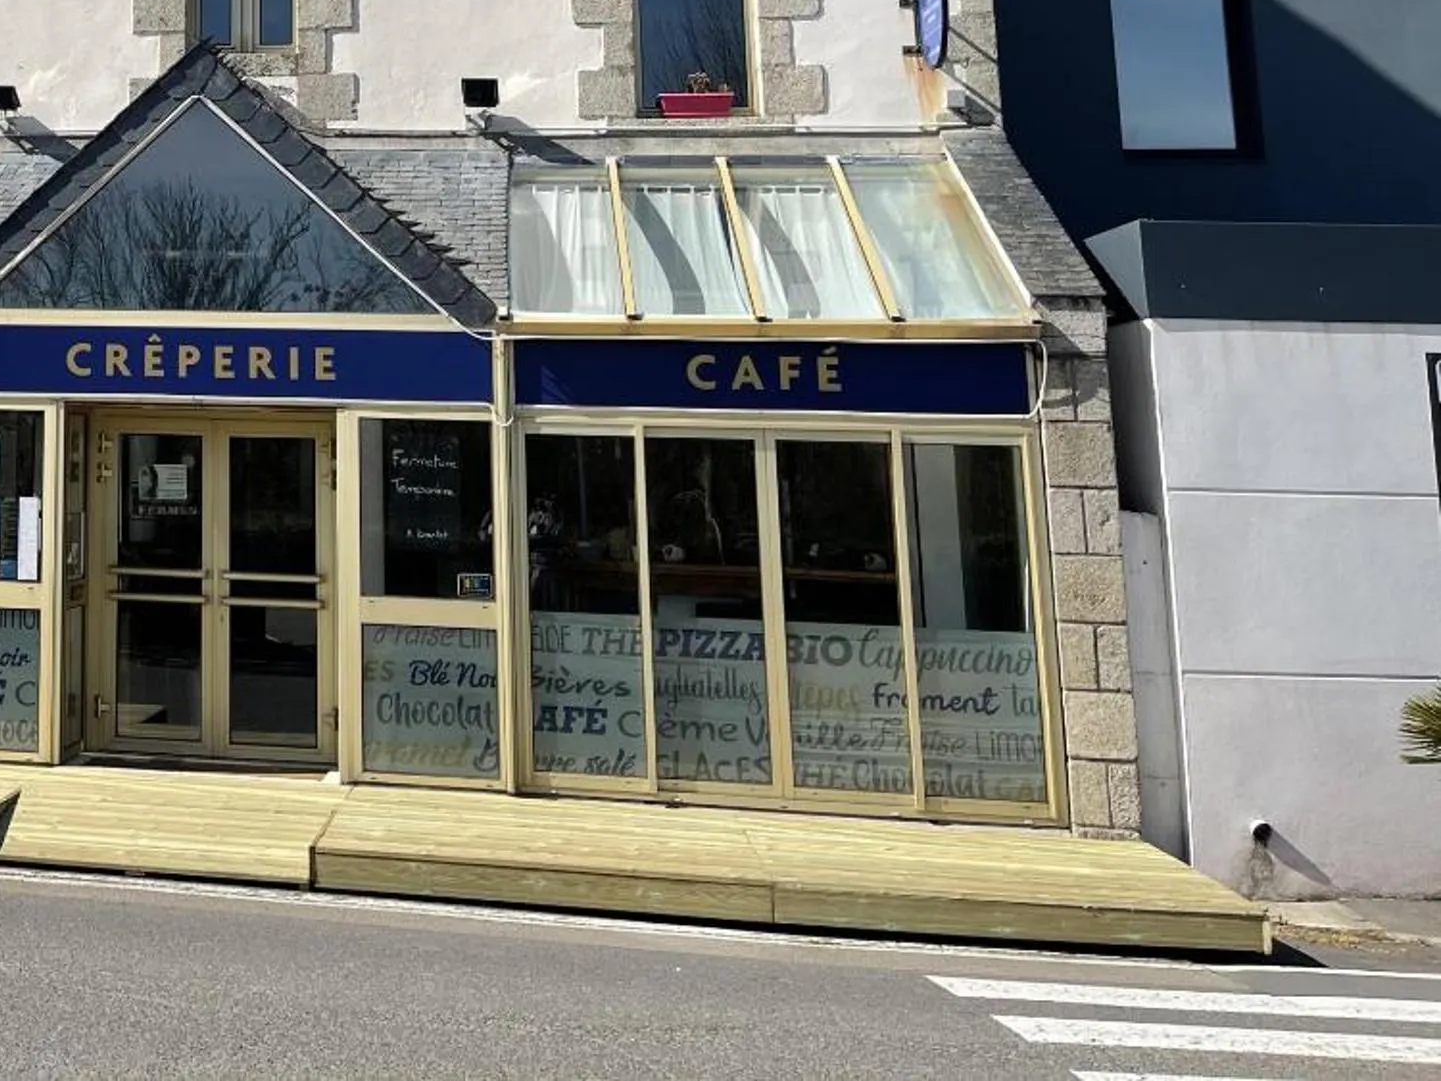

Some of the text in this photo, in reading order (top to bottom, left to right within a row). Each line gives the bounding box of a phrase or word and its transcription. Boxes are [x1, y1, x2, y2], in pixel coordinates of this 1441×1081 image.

[66, 334, 336, 381] CRÊPERIE
[686, 346, 842, 392] CAFÉ
[655, 629, 764, 661] PIZZA
[786, 633, 853, 667] BIO
[409, 658, 450, 686] Blé
[377, 692, 494, 734] Chocolat
